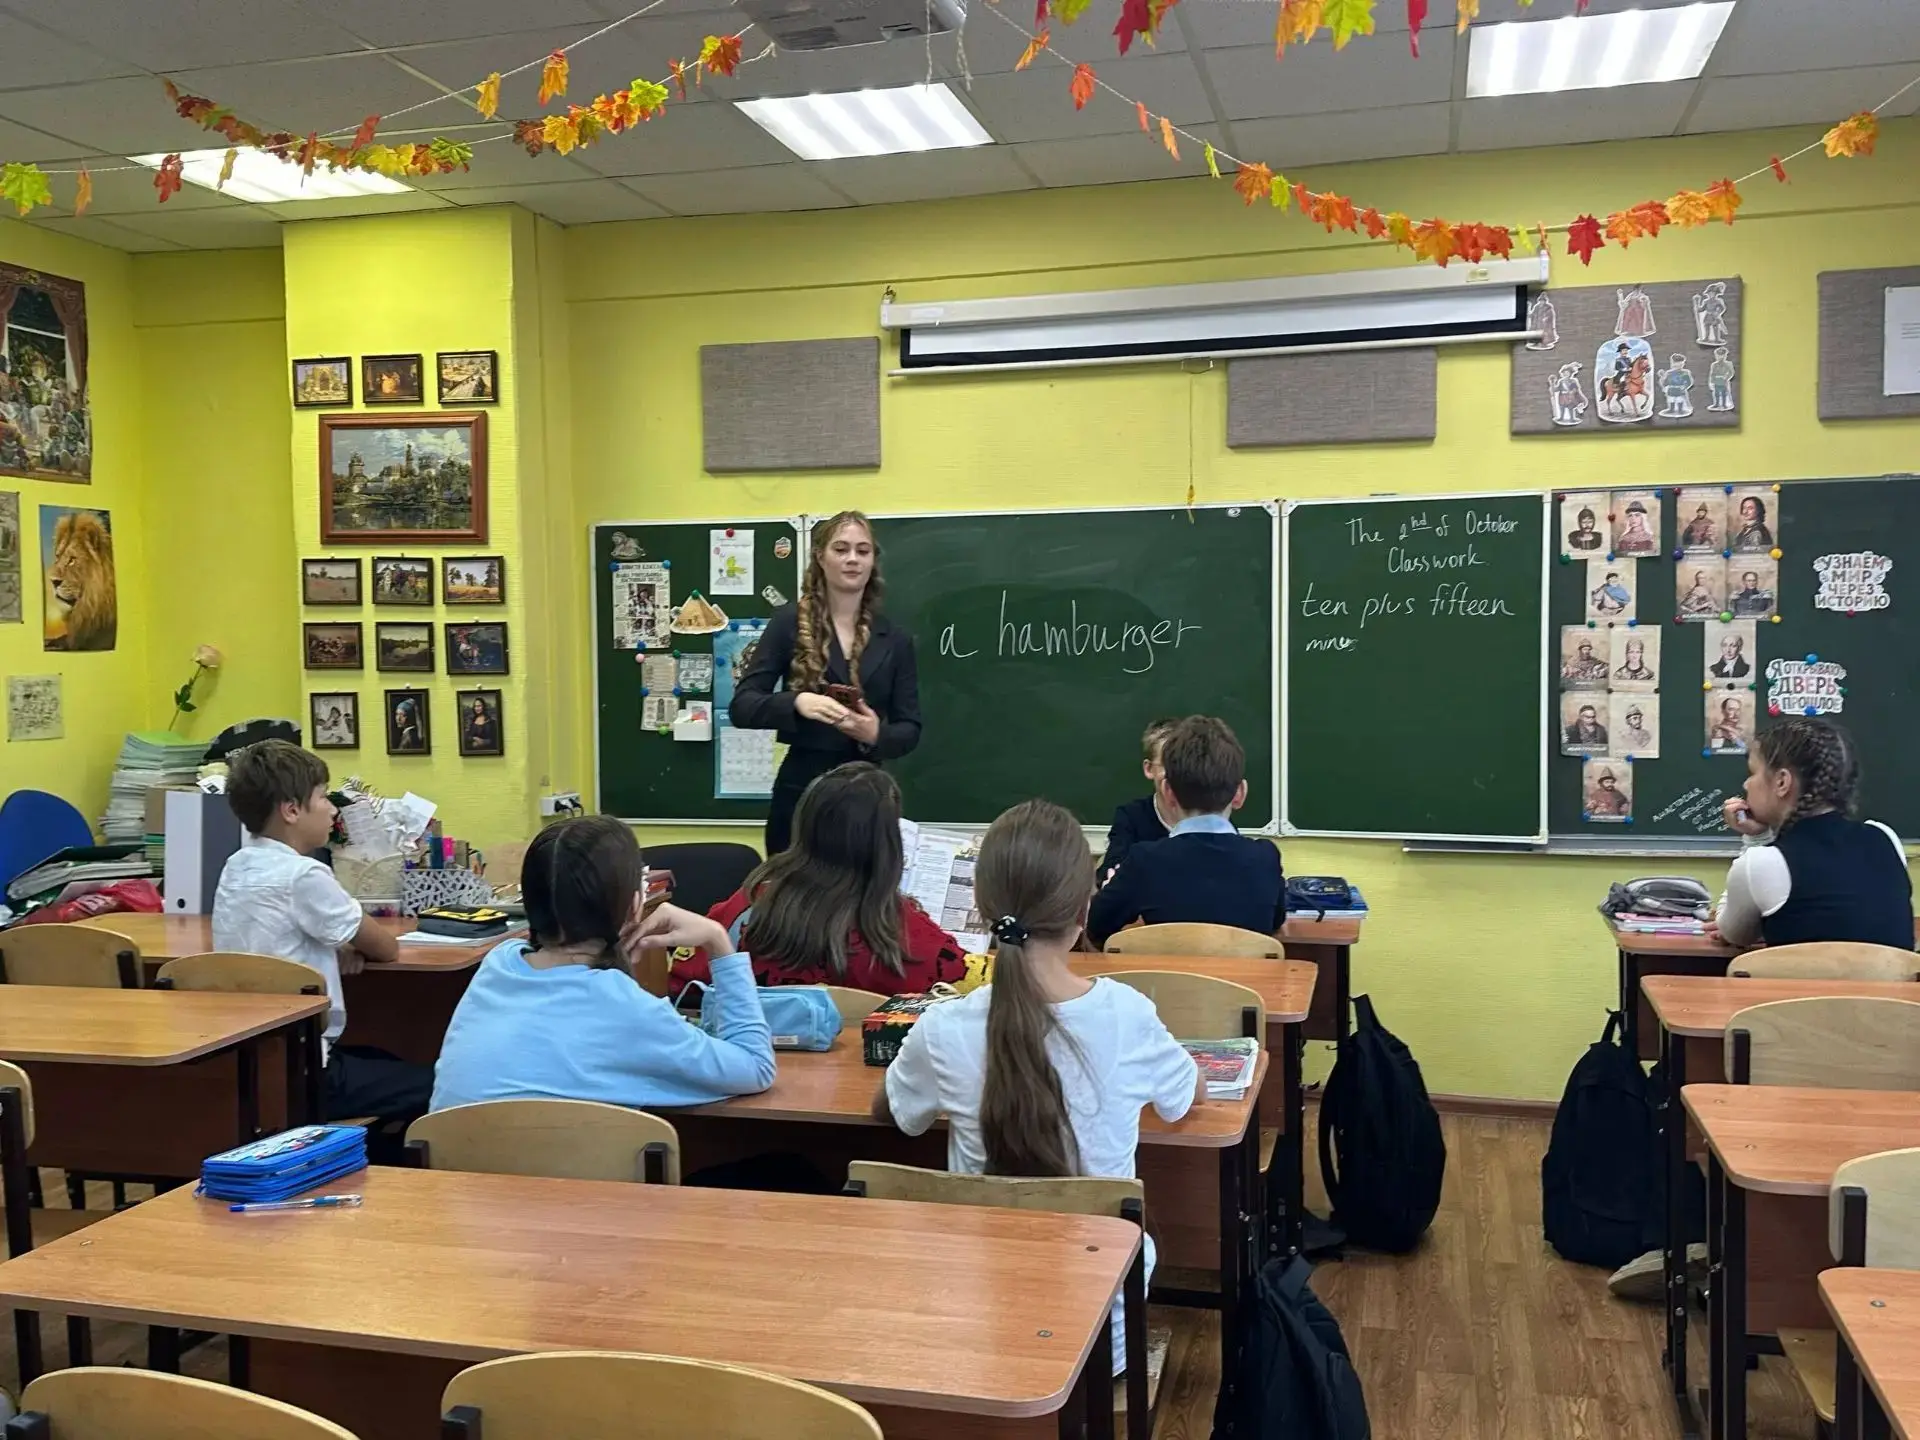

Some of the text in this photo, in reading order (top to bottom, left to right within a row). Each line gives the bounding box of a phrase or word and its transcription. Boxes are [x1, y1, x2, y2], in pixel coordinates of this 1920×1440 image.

[1345, 517, 1385, 546] The
[1434, 514, 1450, 537] of
[1465, 510, 1519, 535] October
[1820, 551, 1885, 570] УЗНАЁМ
[1831, 570, 1873, 583] МИР
[1828, 583, 1875, 595] ЧЕРЕЗ
[1300, 581, 1516, 629] ten plus fifteen
[1817, 595, 1888, 607] ИСТОРИЮ
[939, 589, 1203, 674] a hamburger
[1770, 660, 1782, 677] Я
[1775, 676, 1837, 696] ДВЕРЬ
